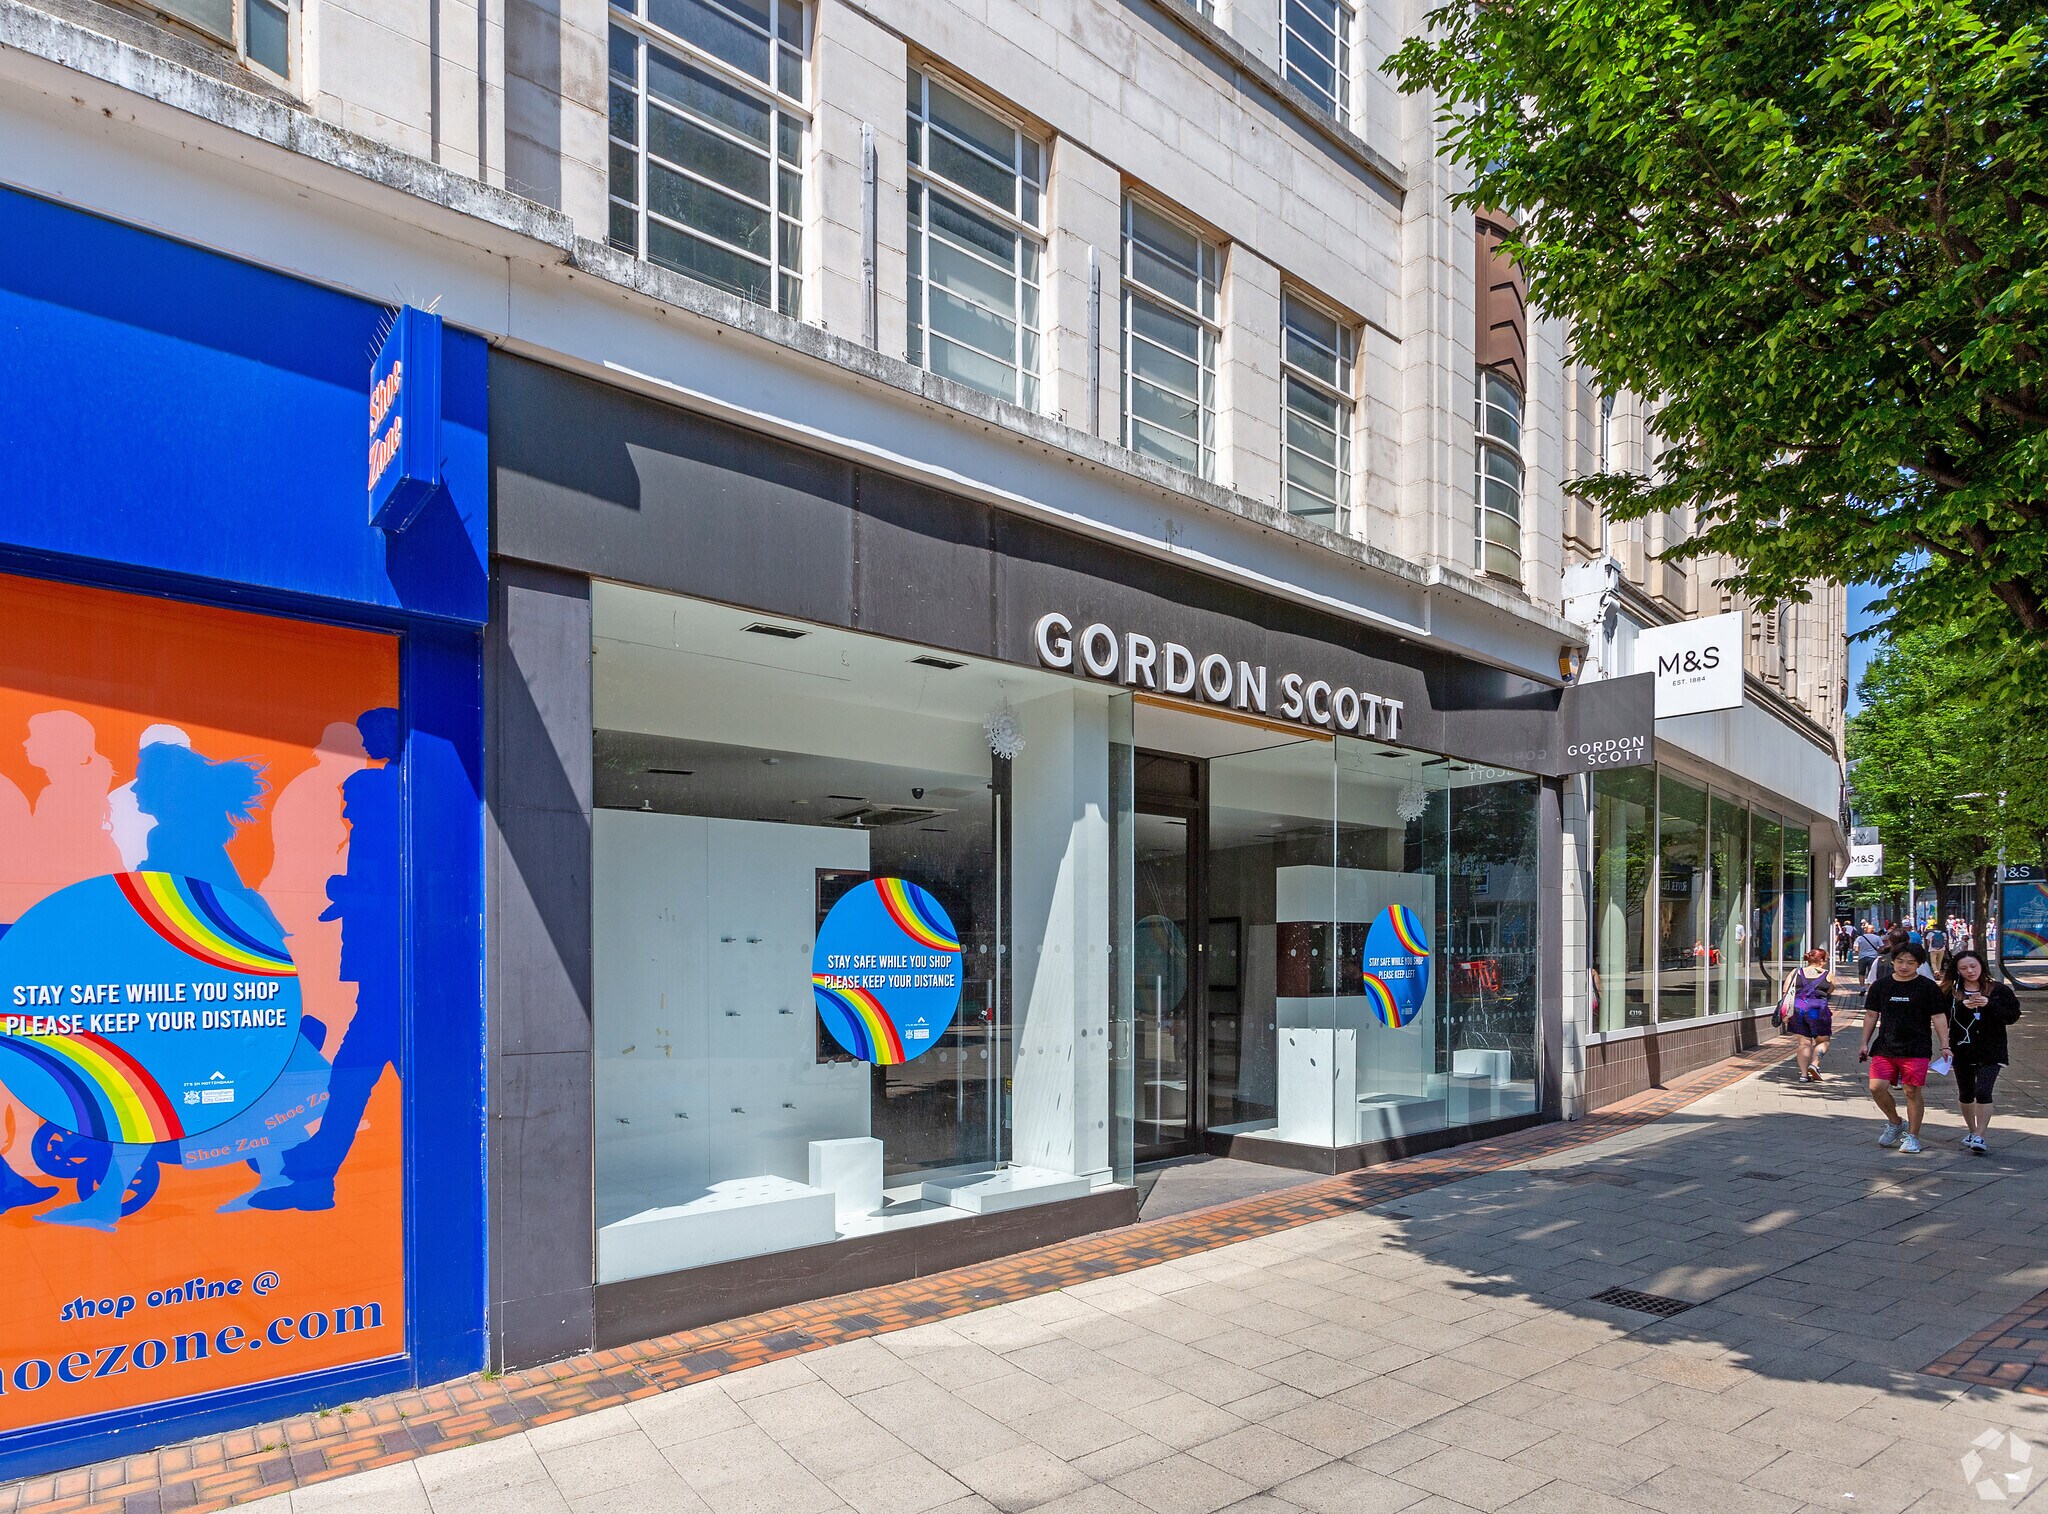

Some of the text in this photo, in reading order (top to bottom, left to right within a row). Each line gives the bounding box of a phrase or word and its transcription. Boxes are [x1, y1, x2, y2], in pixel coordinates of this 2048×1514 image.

[370, 360, 401, 437] Shoe
[368, 416, 401, 491] Zone
[1658, 646, 1720, 677] M&S
[1036, 612, 1404, 741] GORDON SCOTT
[1690, 675, 1706, 683] 1884
[1567, 735, 1645, 756] GORDON
[1587, 747, 1644, 766] SCOTT
[1851, 855, 1875, 864] M&S
[828, 955, 952, 969] STAY SAFE WHILE YOU SHOP
[1406, 969, 1416, 979] LEFT
[13, 981, 280, 1006] STAY SAFE WHILE YOU SHOP
[824, 974, 955, 989] PLEASE KEEP YOUR DISTANCE
[6, 1008, 287, 1036] PLEASE KEEP YOUR DISTANCE
[265, 1104, 305, 1130] Shoe
[186, 1145, 230, 1163] Shoe
[60, 1270, 280, 1322] shop online @
[0, 1302, 384, 1396] oezone.com
